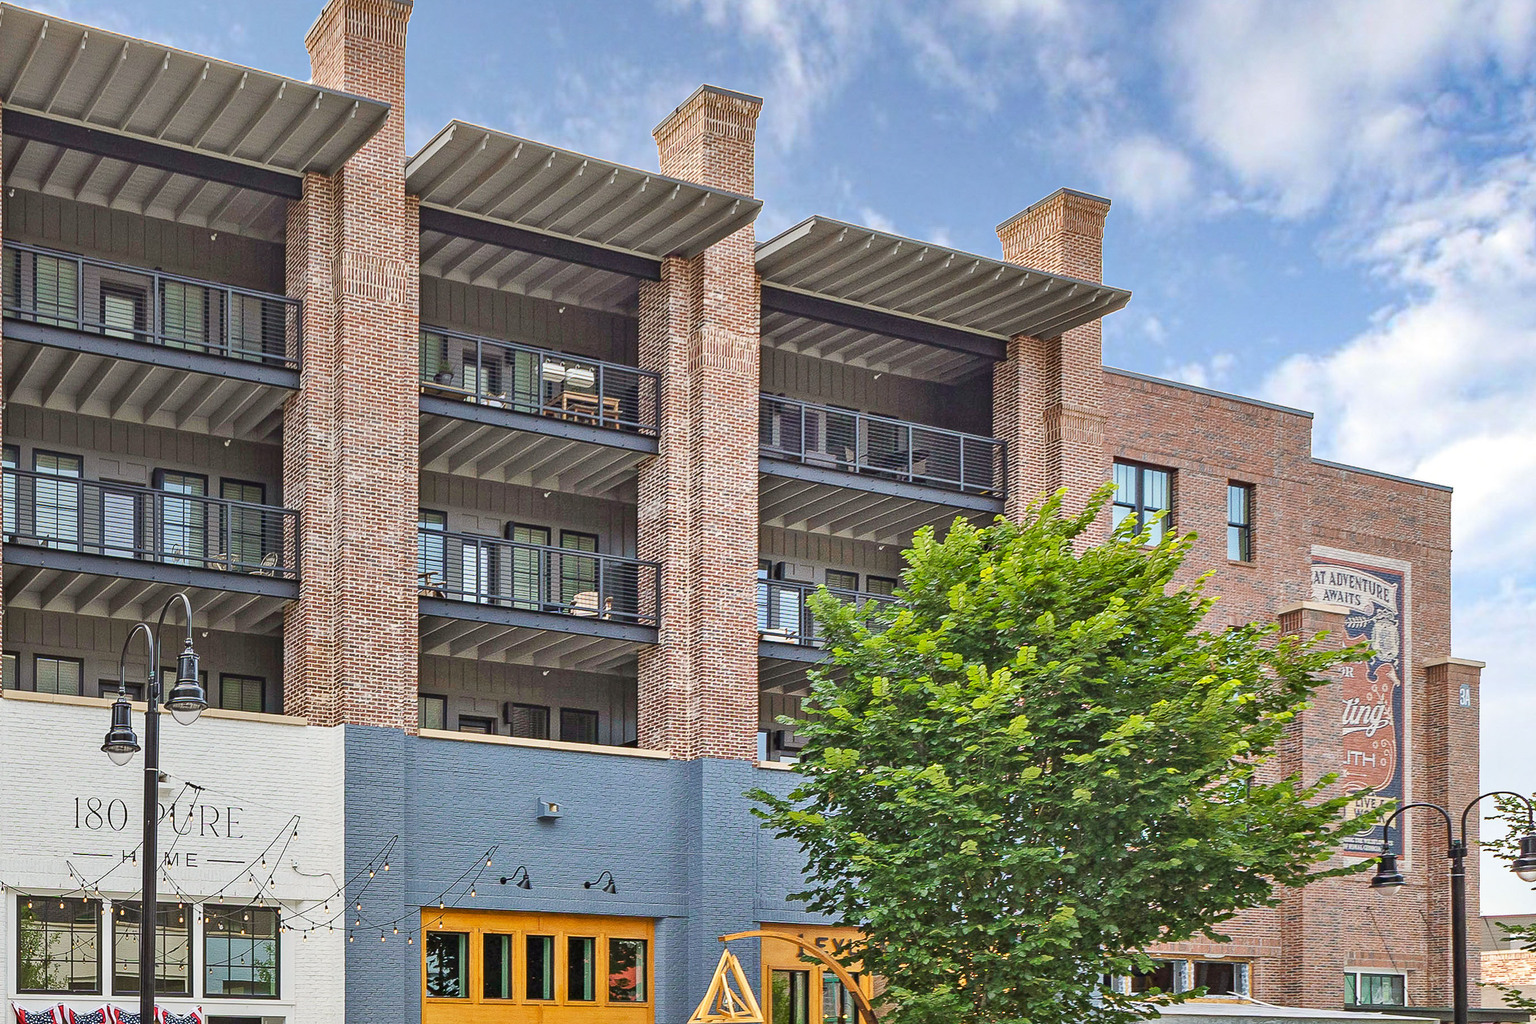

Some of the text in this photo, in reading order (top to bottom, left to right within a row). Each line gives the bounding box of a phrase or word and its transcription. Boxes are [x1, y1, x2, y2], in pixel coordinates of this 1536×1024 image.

[1329, 571, 1390, 603] ADVENTURE
[1323, 588, 1361, 606] AWAITS
[1459, 688, 1470, 706] 3A
[1355, 798, 1377, 809] LIVE
[75, 797, 128, 831] 180
[122, 849, 198, 868] HME
